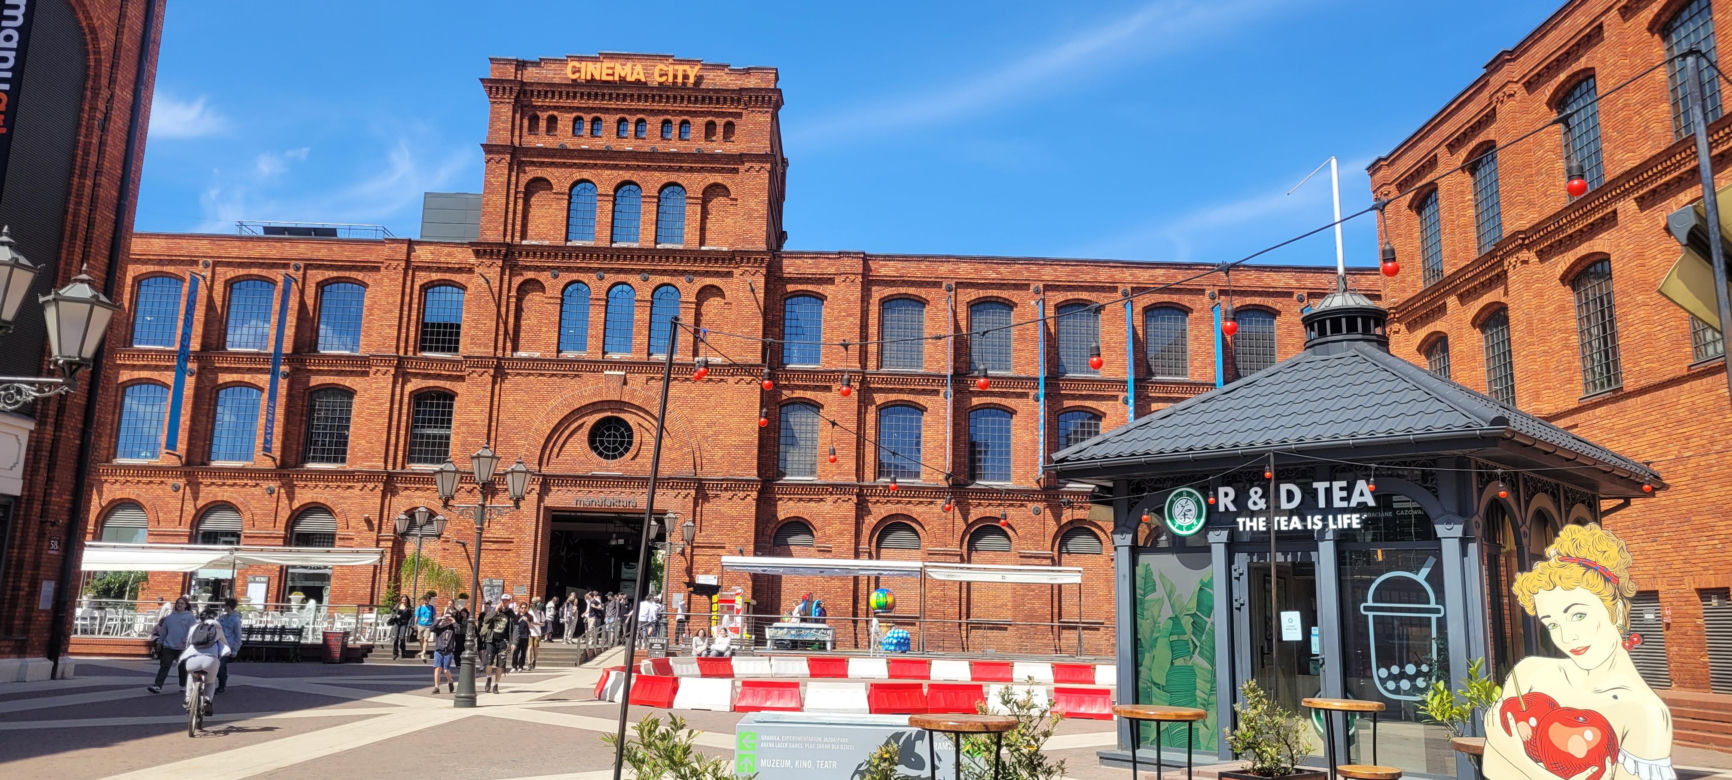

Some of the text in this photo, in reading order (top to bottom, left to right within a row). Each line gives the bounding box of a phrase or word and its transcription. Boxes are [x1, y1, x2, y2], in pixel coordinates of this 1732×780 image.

[566, 60, 700, 85] CINEMA CITY
[575, 496, 638, 508] manufaktura
[1217, 479, 1376, 512] R & D TEA
[1236, 513, 1362, 531] THE TEA IS LIFE
[49, 540, 59, 550] 58
[760, 758, 838, 769] MUZEUM, KINO, TEATR
